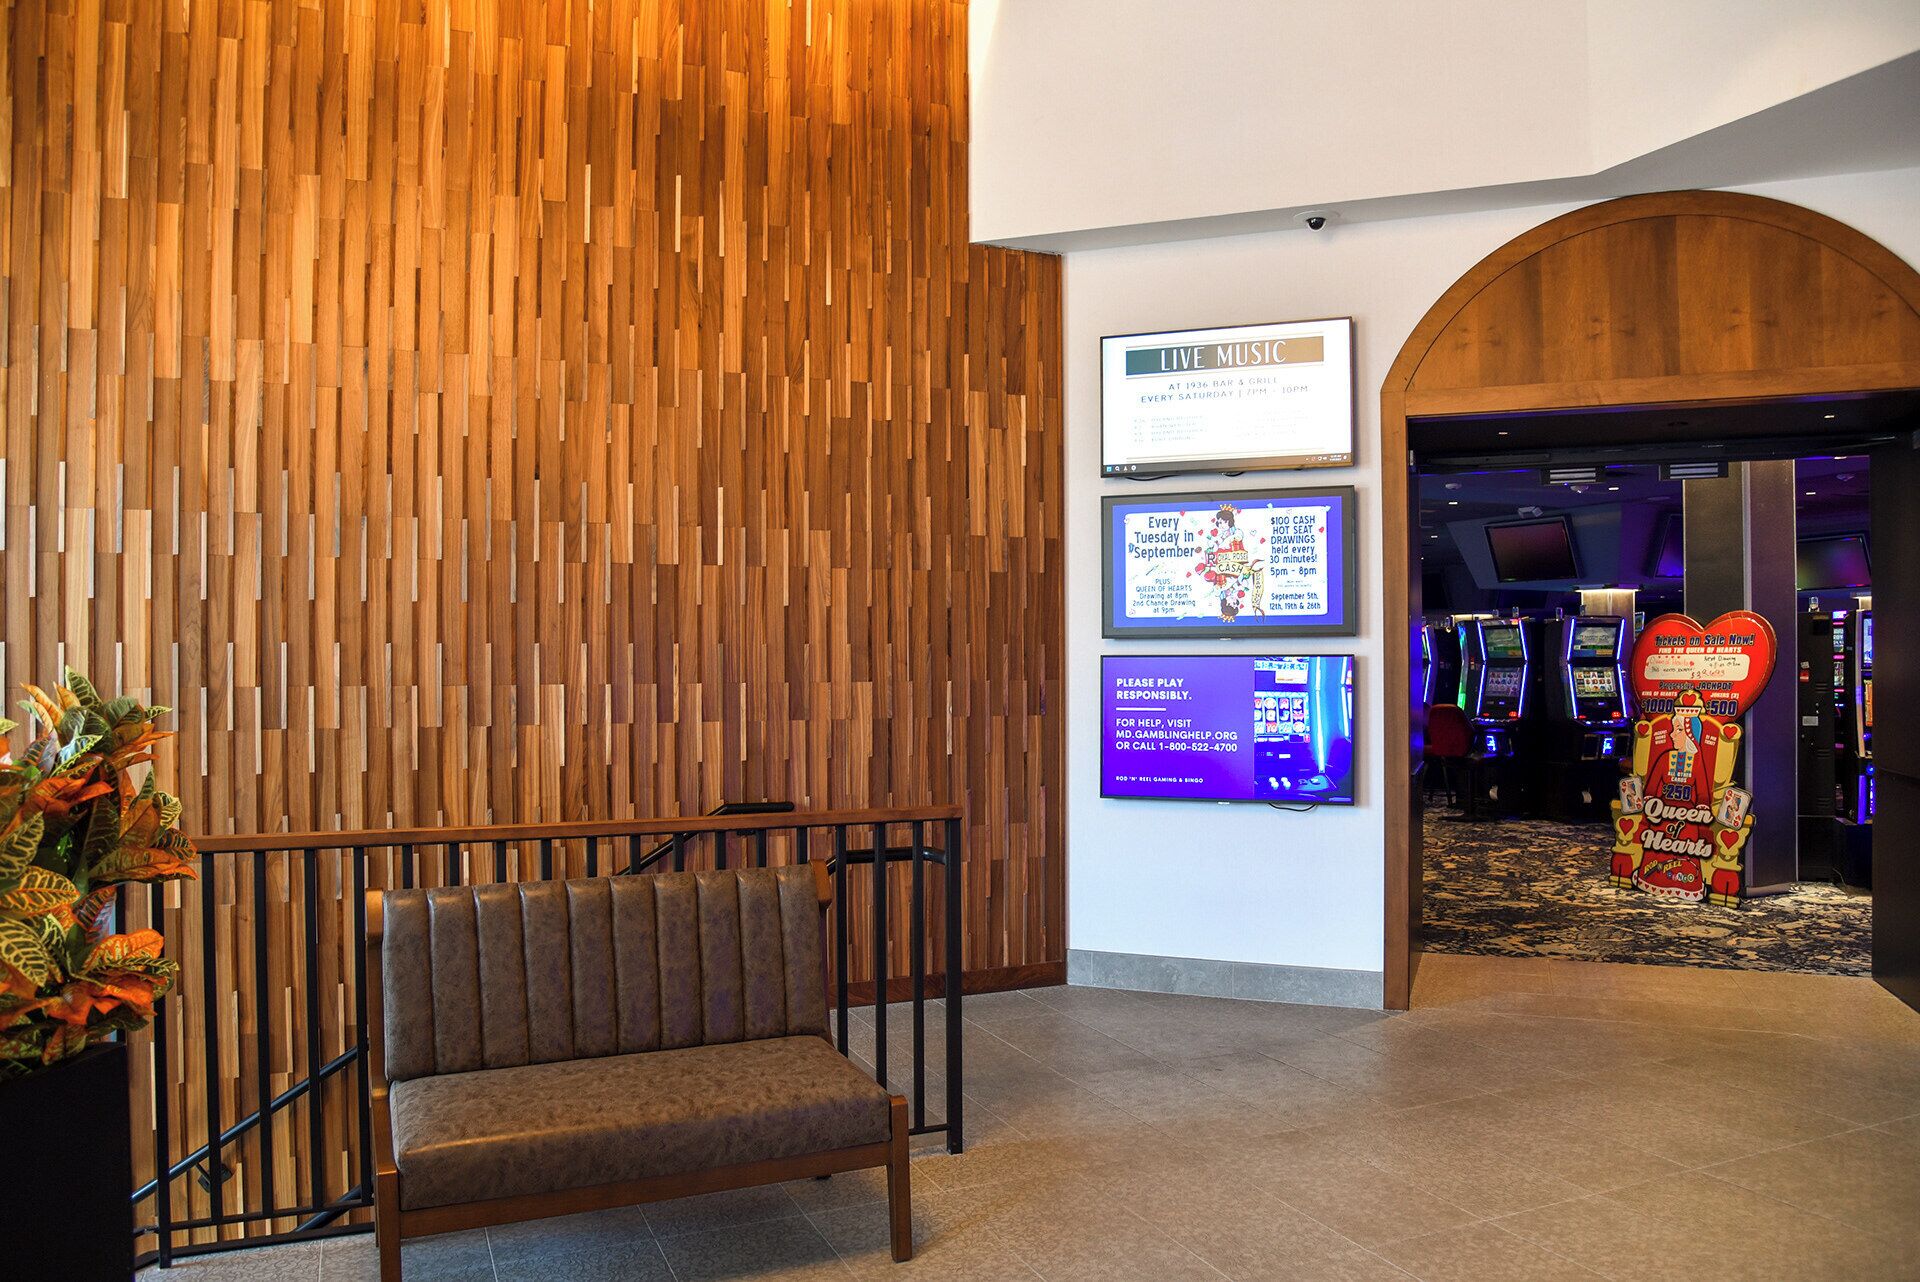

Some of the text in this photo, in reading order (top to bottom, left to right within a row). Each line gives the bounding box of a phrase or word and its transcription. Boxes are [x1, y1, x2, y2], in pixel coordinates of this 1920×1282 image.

[1161, 340, 1287, 371] LIVE MUSIC
[1186, 381, 1208, 389] 1936
[1213, 379, 1233, 387] BAR
[1141, 394, 1173, 403] EVERY
[1179, 390, 1234, 400] SATURDAY
[1282, 385, 1308, 394] 10PM
[1148, 516, 1180, 531] Every
[1270, 515, 1316, 525] $100 CASH
[1272, 525, 1313, 534] HOT SEAT
[1134, 530, 1194, 546] Tuesday in
[1270, 535, 1316, 544] DRAWINGS
[1134, 546, 1195, 562] September
[1271, 545, 1315, 555] held every
[1270, 554, 1318, 563] 30 minutes!
[1218, 563, 1244, 574] CASH
[1270, 567, 1288, 577] 5pm
[1298, 566, 1317, 577] 8pm
[1271, 592, 1305, 602] September
[1655, 633, 1756, 647] Tickets on Sale Now!
[1116, 678, 1184, 688] PLEASE PLAY
[1696, 681, 1733, 690] JACKPOT
[1116, 690, 1193, 700] RESPONSIBLY.
[1641, 698, 1674, 713] $1000
[1706, 700, 1738, 716] $500
[1116, 718, 1192, 729] FOR HELP, VISIT
[1116, 730, 1238, 740] MD.GAMBLINGHELP.ORG
[1116, 741, 1238, 752] OR CALL 1-800-522-4700
[1662, 784, 1692, 800] $250
[1644, 798, 1714, 824] Queen
[1665, 820, 1686, 839] of
[1641, 829, 1713, 857] Hearts
